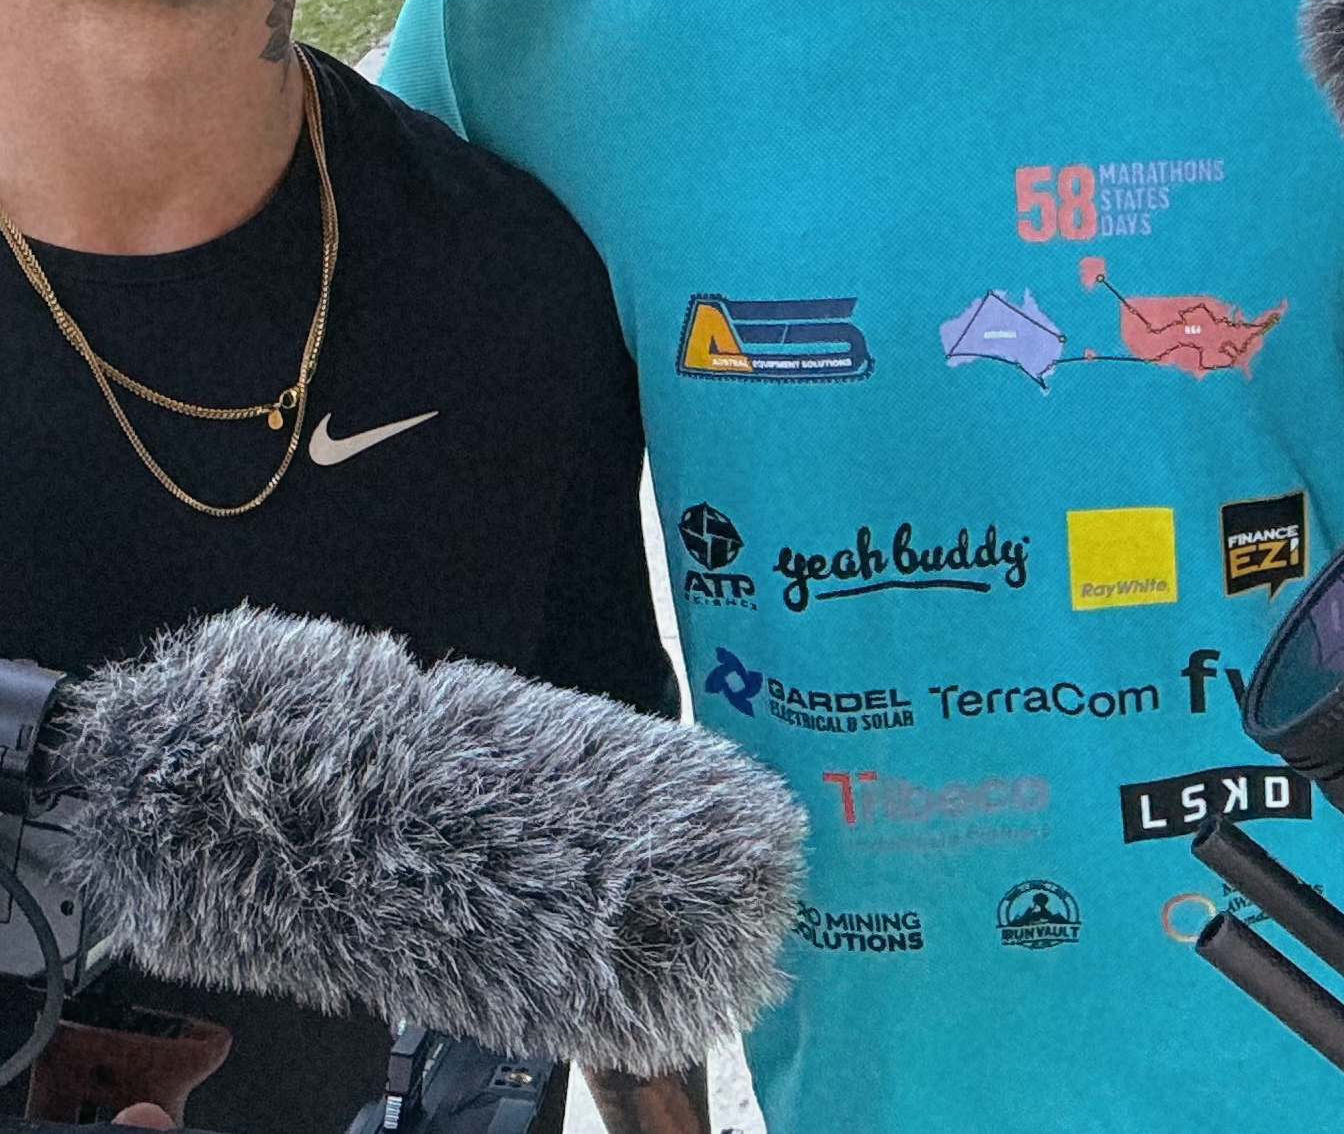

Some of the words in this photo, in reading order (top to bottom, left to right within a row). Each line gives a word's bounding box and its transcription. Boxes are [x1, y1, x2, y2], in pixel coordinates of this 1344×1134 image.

[1015, 165, 1097, 243] 58
[1099, 158, 1225, 185] MARATHONS
[1100, 186, 1170, 211] STATES
[1100, 212, 1152, 237] DAYS
[801, 357, 852, 369] SOLUTIONS
[1227, 524, 1300, 549] FINANCE
[773, 526, 888, 612] yeah
[893, 522, 1029, 588] buddy
[683, 570, 755, 598] ATP
[928, 682, 1159, 720] TerraCom
[862, 709, 915, 732] SOLAR
[825, 911, 922, 933] MINING
